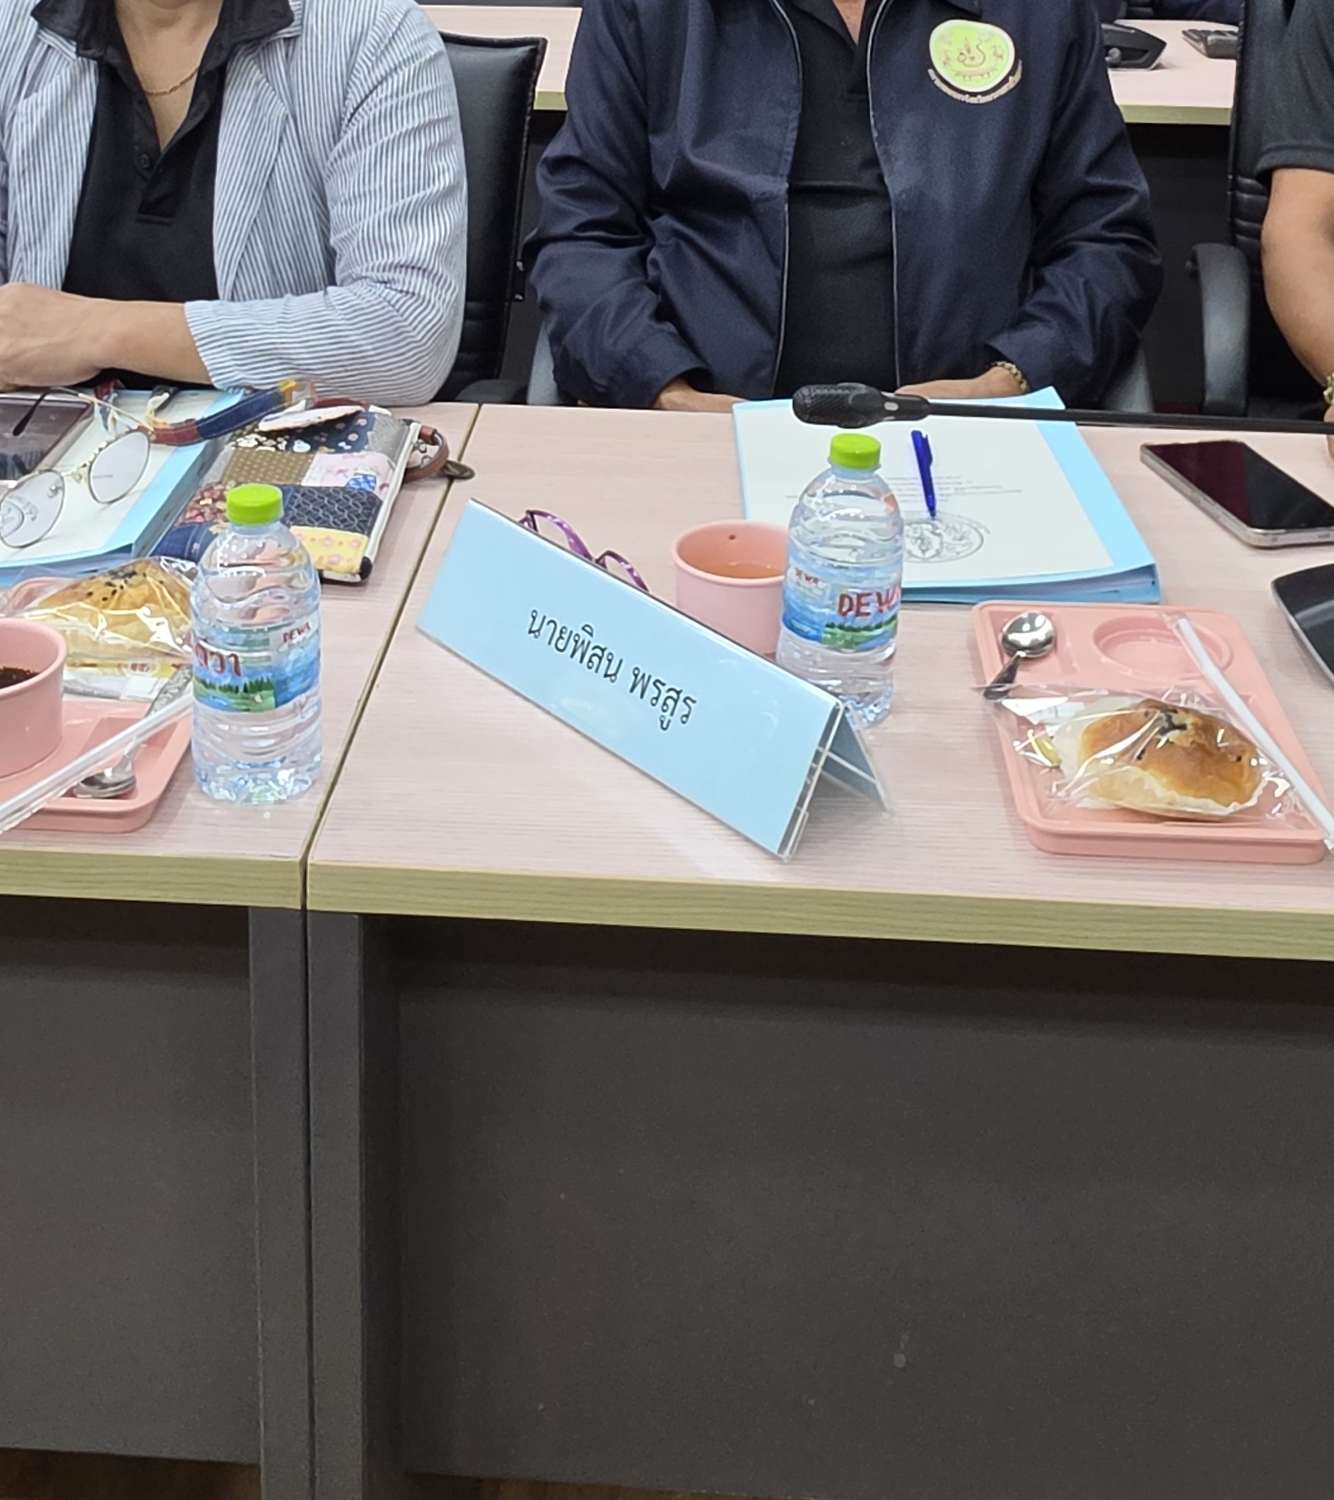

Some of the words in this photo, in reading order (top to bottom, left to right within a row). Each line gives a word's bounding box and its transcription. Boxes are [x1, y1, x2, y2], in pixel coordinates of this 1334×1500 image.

[527, 609, 624, 684] นายพิสน
[629, 666, 697, 731] พรสูร
